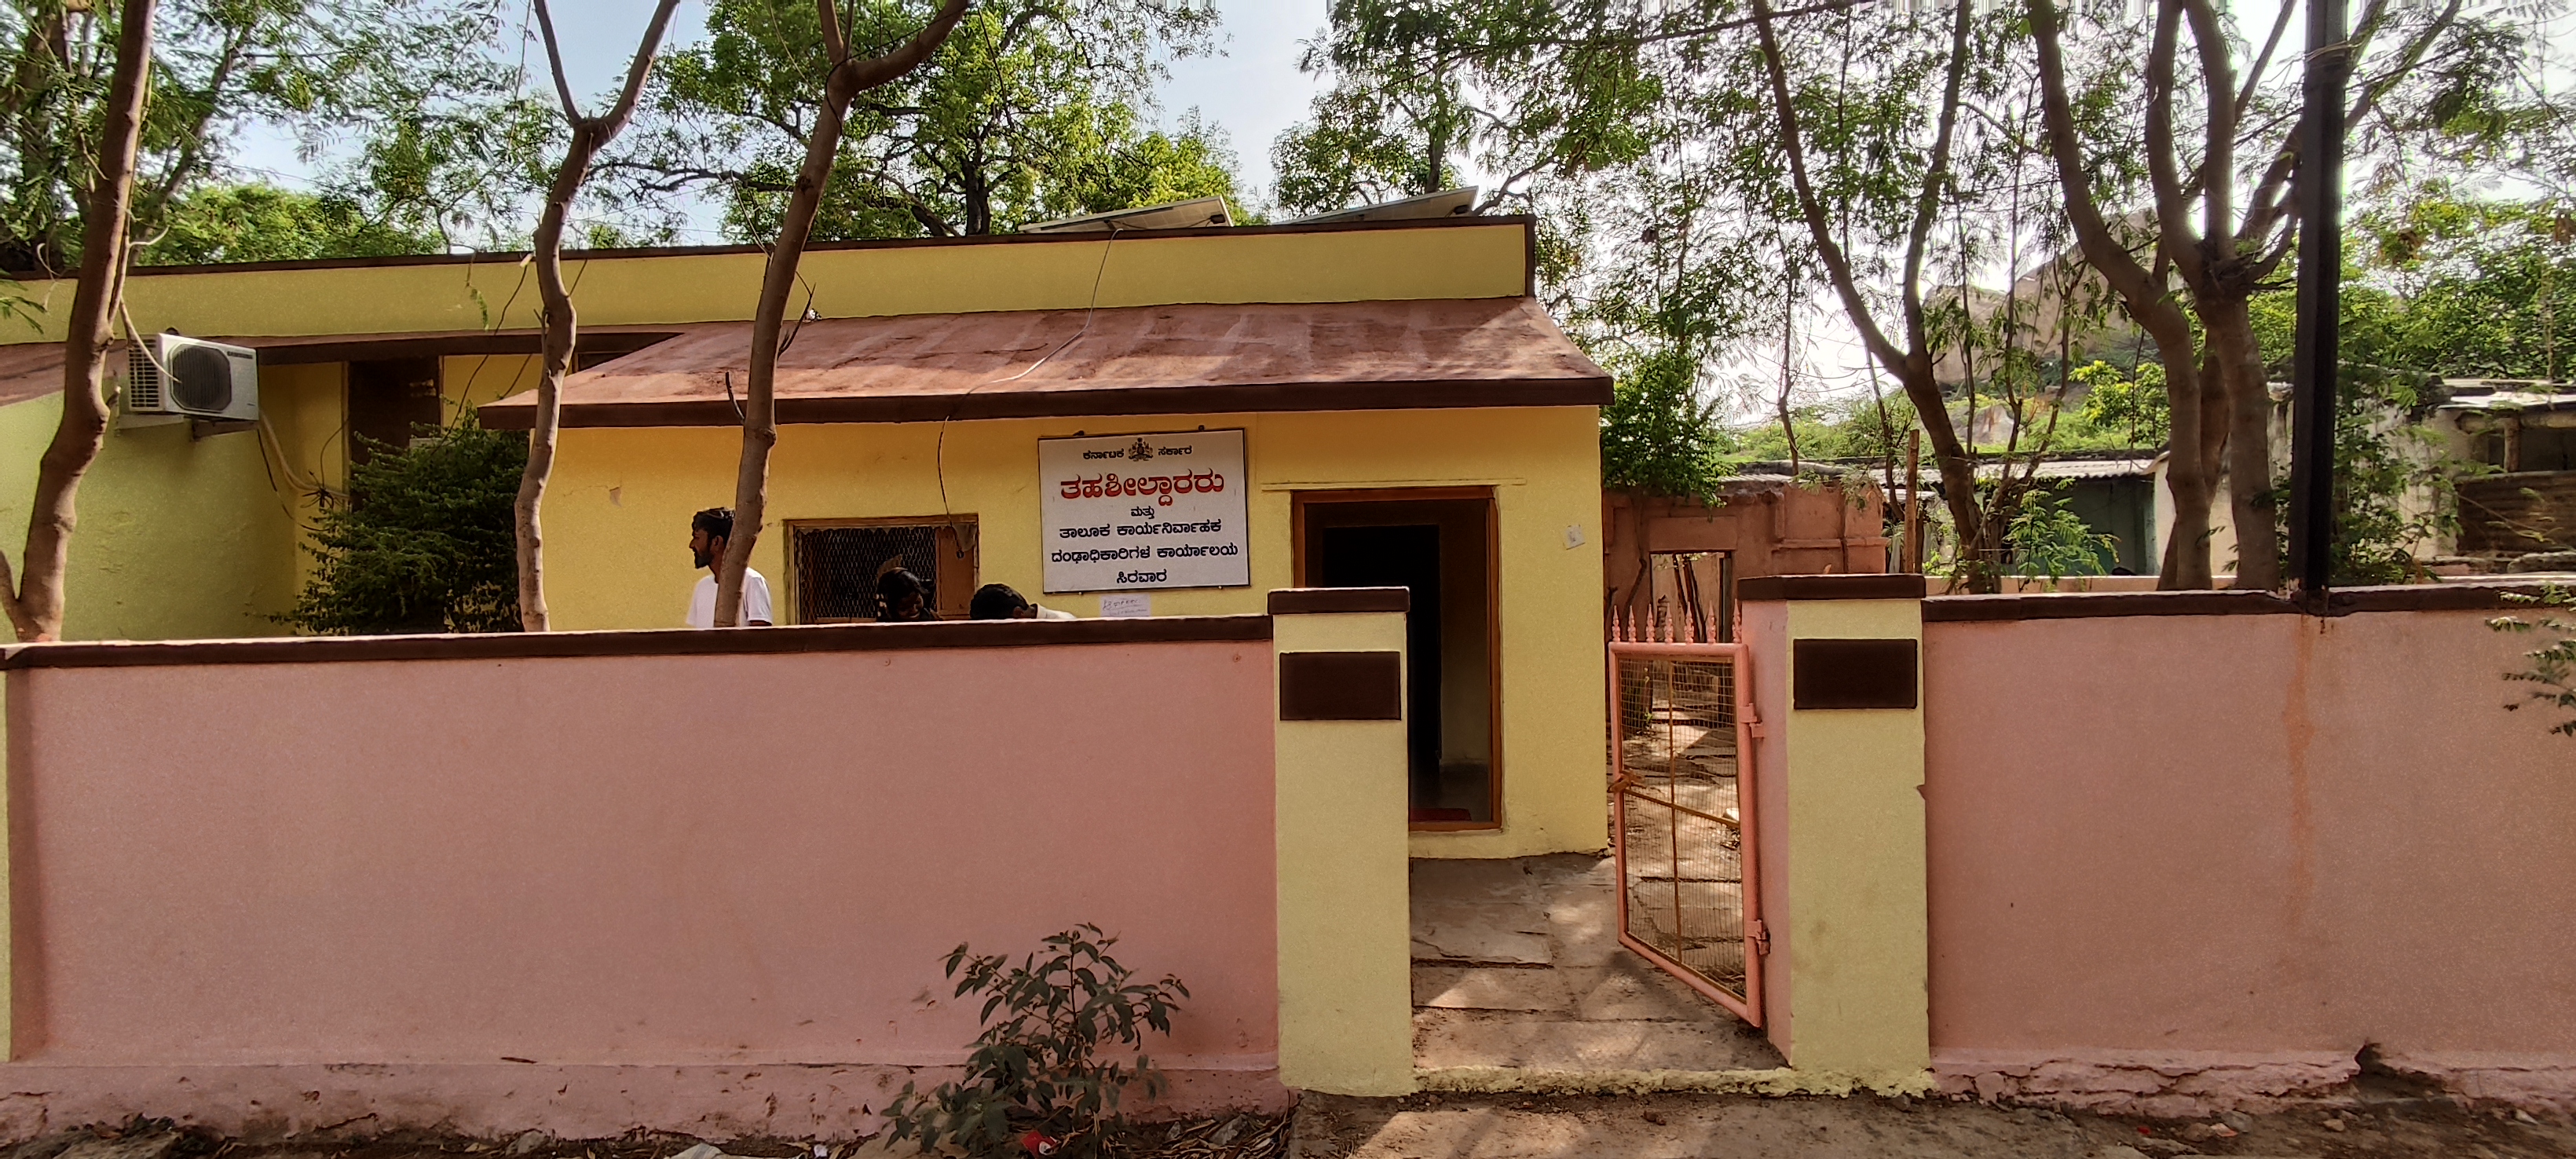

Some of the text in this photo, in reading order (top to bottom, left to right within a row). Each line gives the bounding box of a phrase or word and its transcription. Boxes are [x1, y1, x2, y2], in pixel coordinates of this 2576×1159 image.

[1083, 445, 1191, 459] ಕರ್ನಾಟಕ ಸರ್ಕಾರ
[1061, 468, 1224, 506] ತಹಶೀಲ್ದಾರರು
[1131, 506, 1154, 519] ಮತ್ತು
[1059, 519, 1221, 538] ತಾಲೂಕ ಕಾರ್ಯನಿರ್ವಾಹಕ
[1157, 543, 1238, 558] ಕಾರ್ಯಾಲಯ
[1117, 569, 1166, 583] ಸಿರವಾರ
